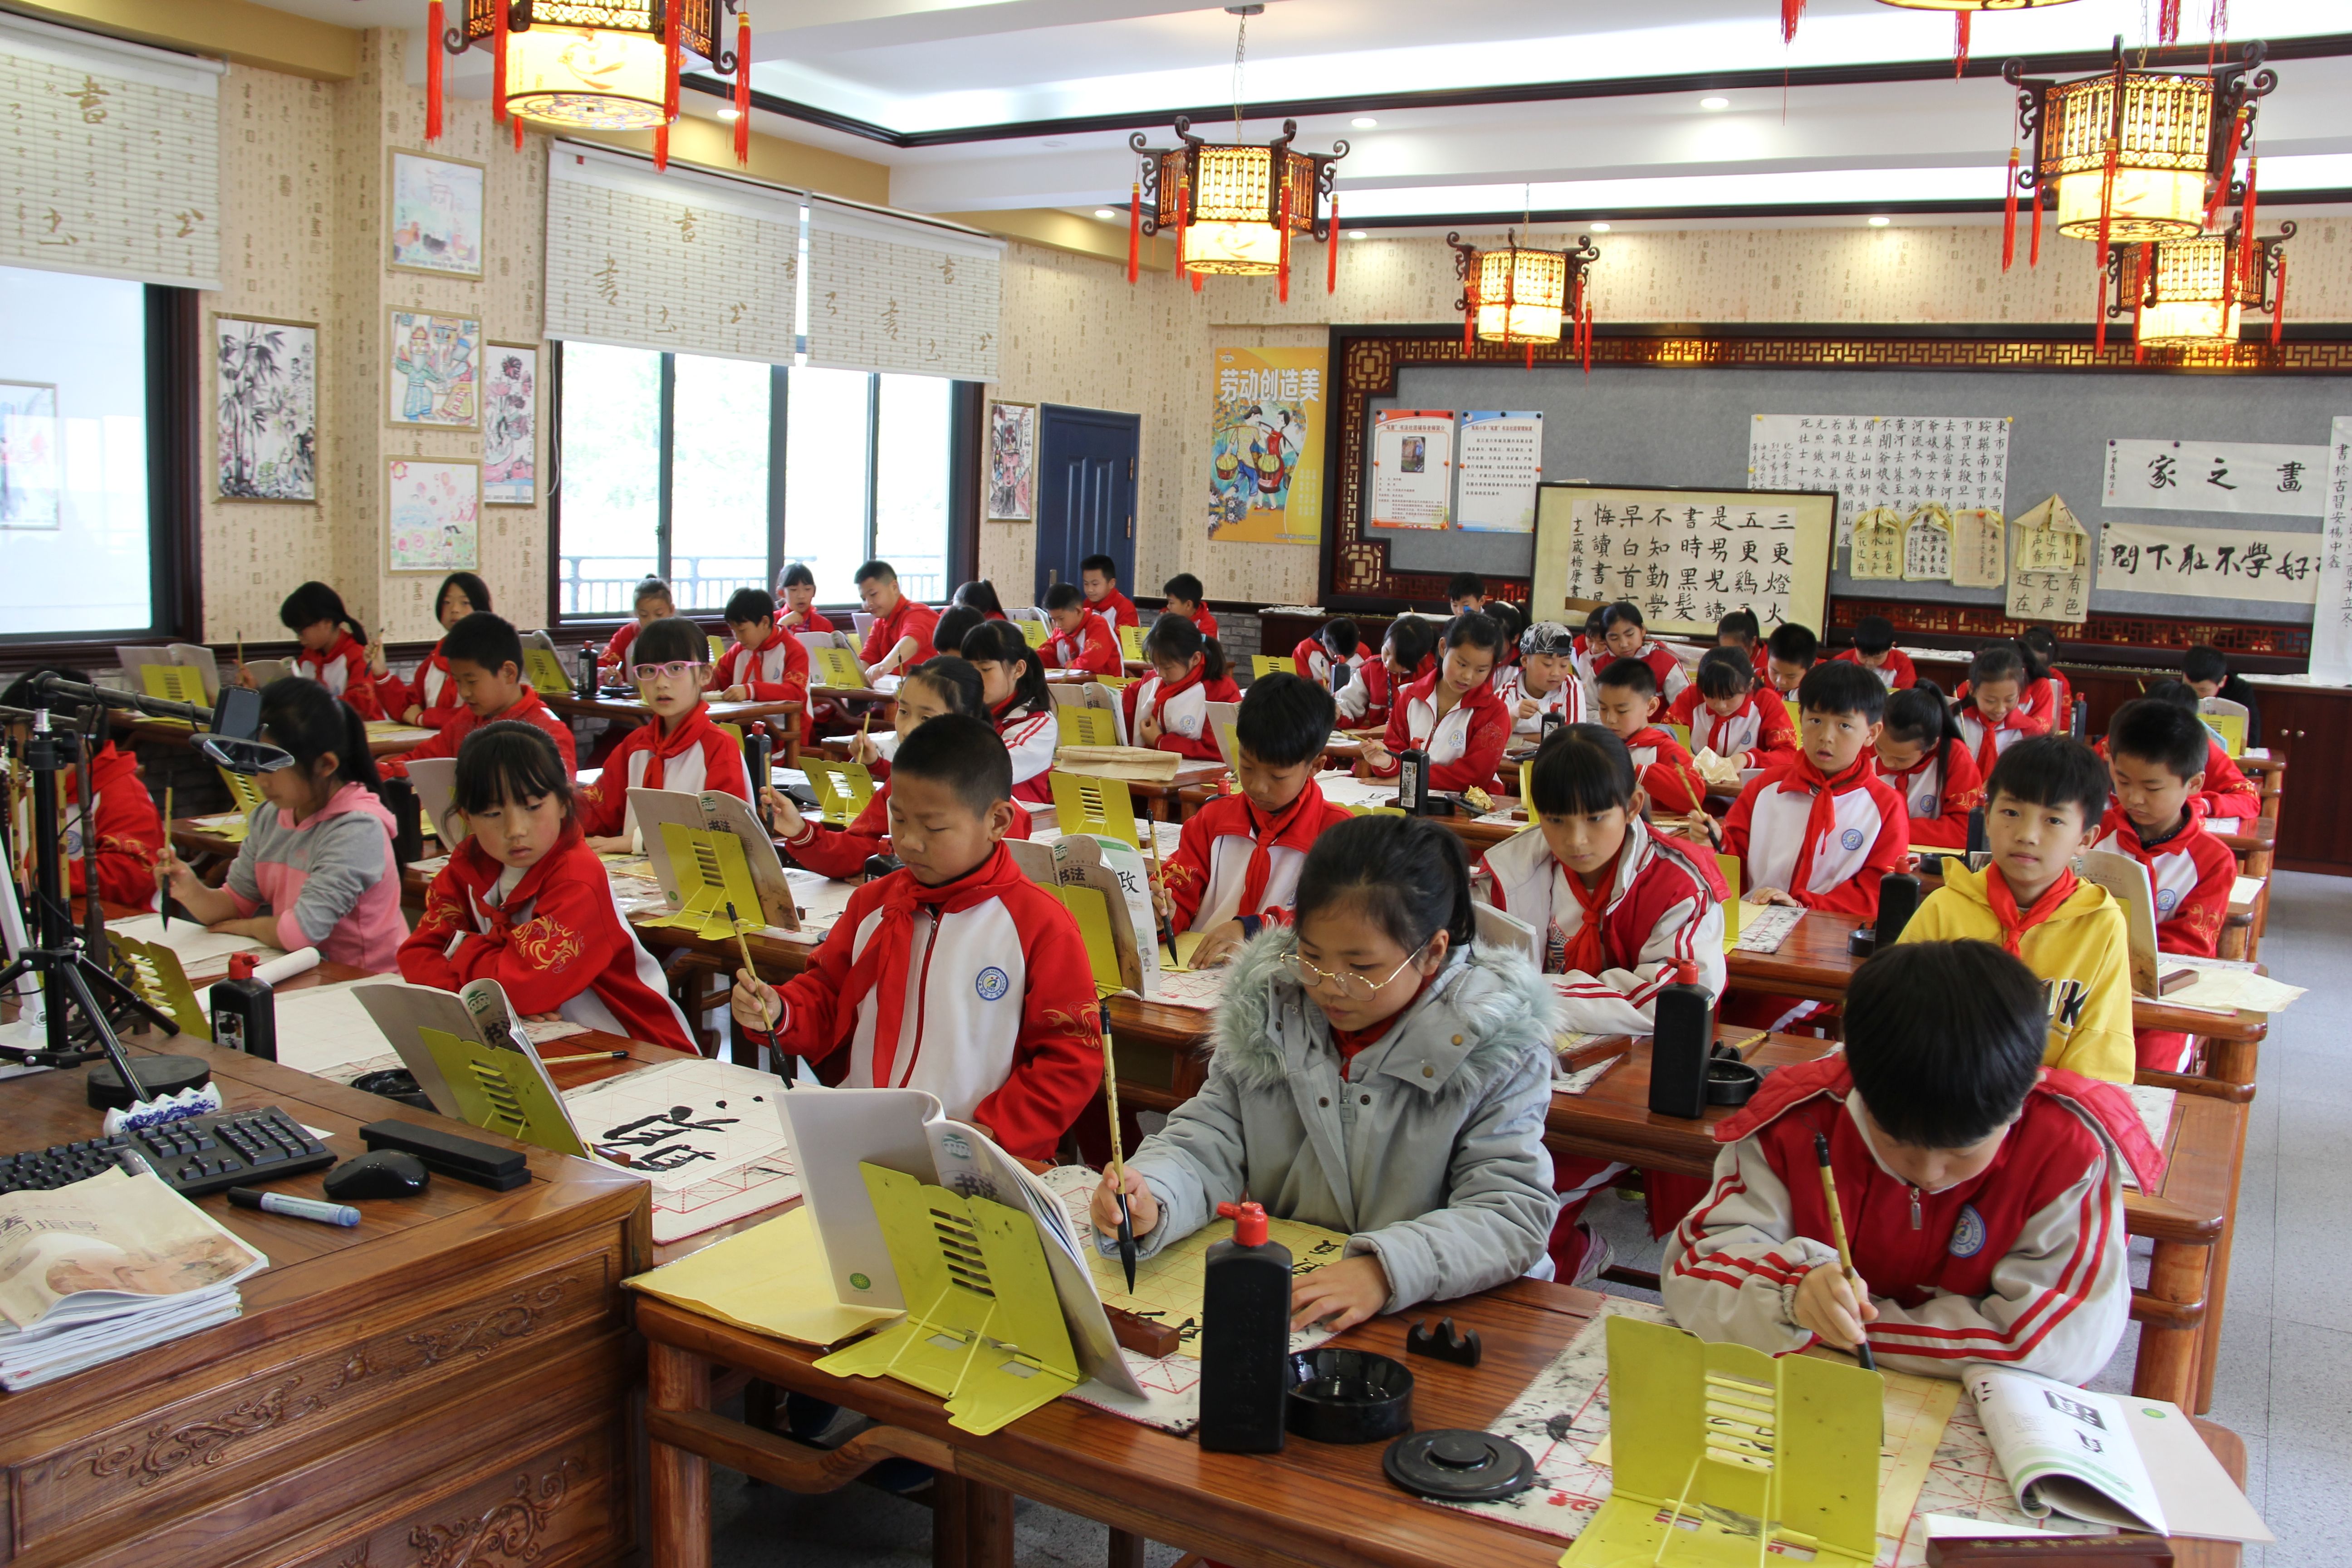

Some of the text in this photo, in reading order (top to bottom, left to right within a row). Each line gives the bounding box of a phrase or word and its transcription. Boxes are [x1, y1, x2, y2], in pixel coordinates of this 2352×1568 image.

[1220, 368, 1319, 402] 劳动创造美
[1058, 867, 1086, 884] 书法
[955, 1173, 1000, 1199] 书法
